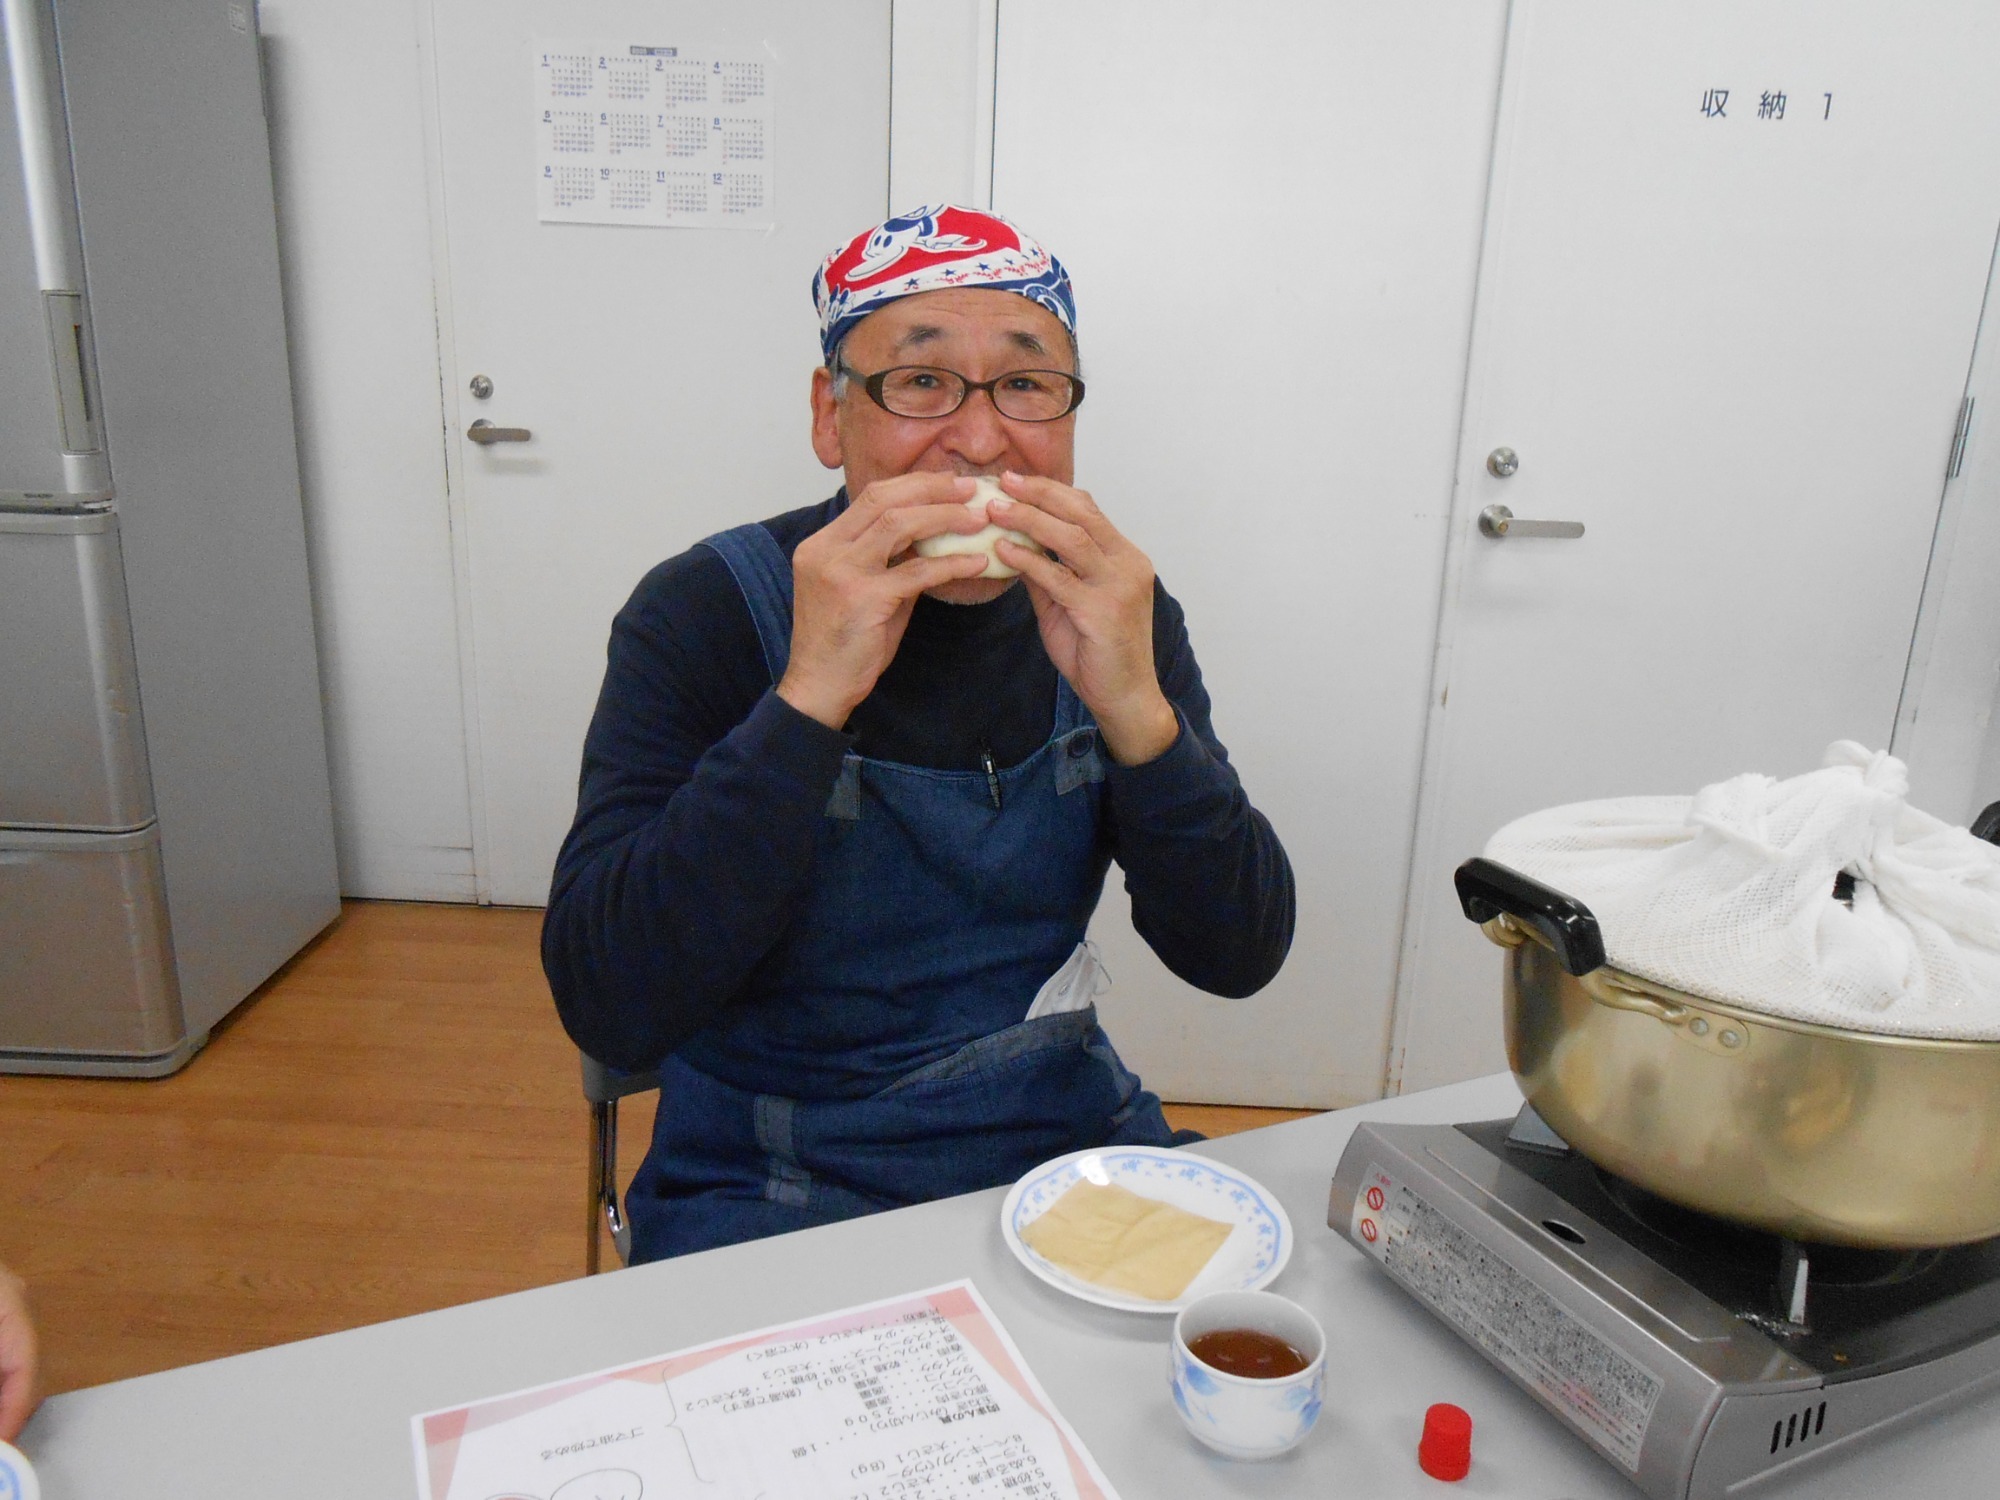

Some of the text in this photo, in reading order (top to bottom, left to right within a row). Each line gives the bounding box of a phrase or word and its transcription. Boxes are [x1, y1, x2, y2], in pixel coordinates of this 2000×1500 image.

[543, 54, 548, 62] 1
[600, 57, 606, 65] 2
[713, 62, 720, 70] 4
[544, 110, 551, 119] 5
[600, 112, 607, 121] 6
[713, 117, 721, 126] 8
[544, 165, 551, 173] 9
[600, 168, 610, 176] 10
[656, 170, 665, 179] 11
[713, 172, 722, 181] 12
